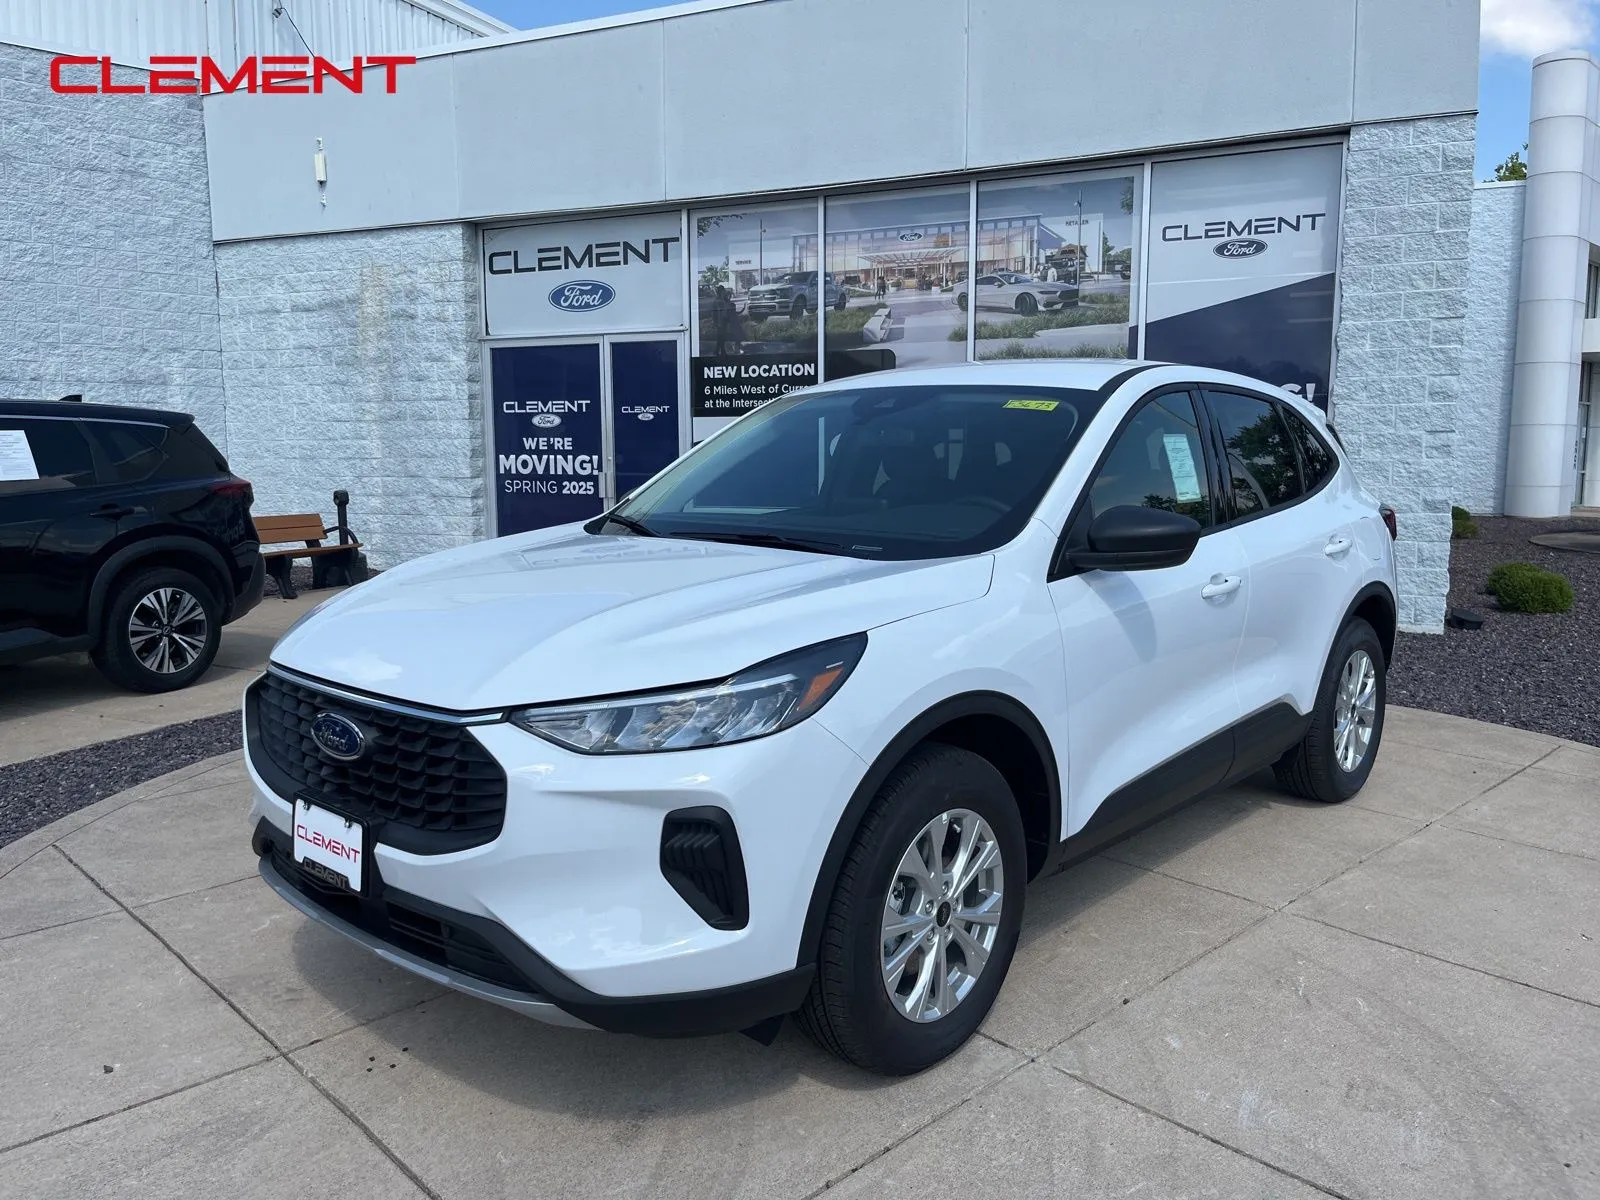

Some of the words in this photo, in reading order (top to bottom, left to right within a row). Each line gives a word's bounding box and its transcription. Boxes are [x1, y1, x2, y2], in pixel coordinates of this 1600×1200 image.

[1161, 212, 1327, 242] CLEMENT
[488, 236, 680, 275] CLEMENT
[1222, 240, 1257, 256] Ford
[559, 284, 604, 308] Ford
[703, 365, 738, 379] NEW
[740, 363, 816, 378] LOCATION
[704, 386, 711, 395] 6
[713, 384, 738, 395] Miles
[740, 384, 766, 394] West
[768, 384, 779, 394] of
[503, 400, 591, 413] CLEMENT
[621, 405, 670, 413] CLEMENT
[704, 400, 714, 408] at
[716, 399, 731, 408] the
[522, 437, 573, 450] WE'RE
[499, 454, 599, 476] MOVING!
[504, 480, 558, 494] SPRING
[561, 481, 595, 495] 2025
[317, 720, 350, 751] Ford
[296, 824, 361, 864] CLEMENT
[303, 857, 349, 890] CLEMENT
